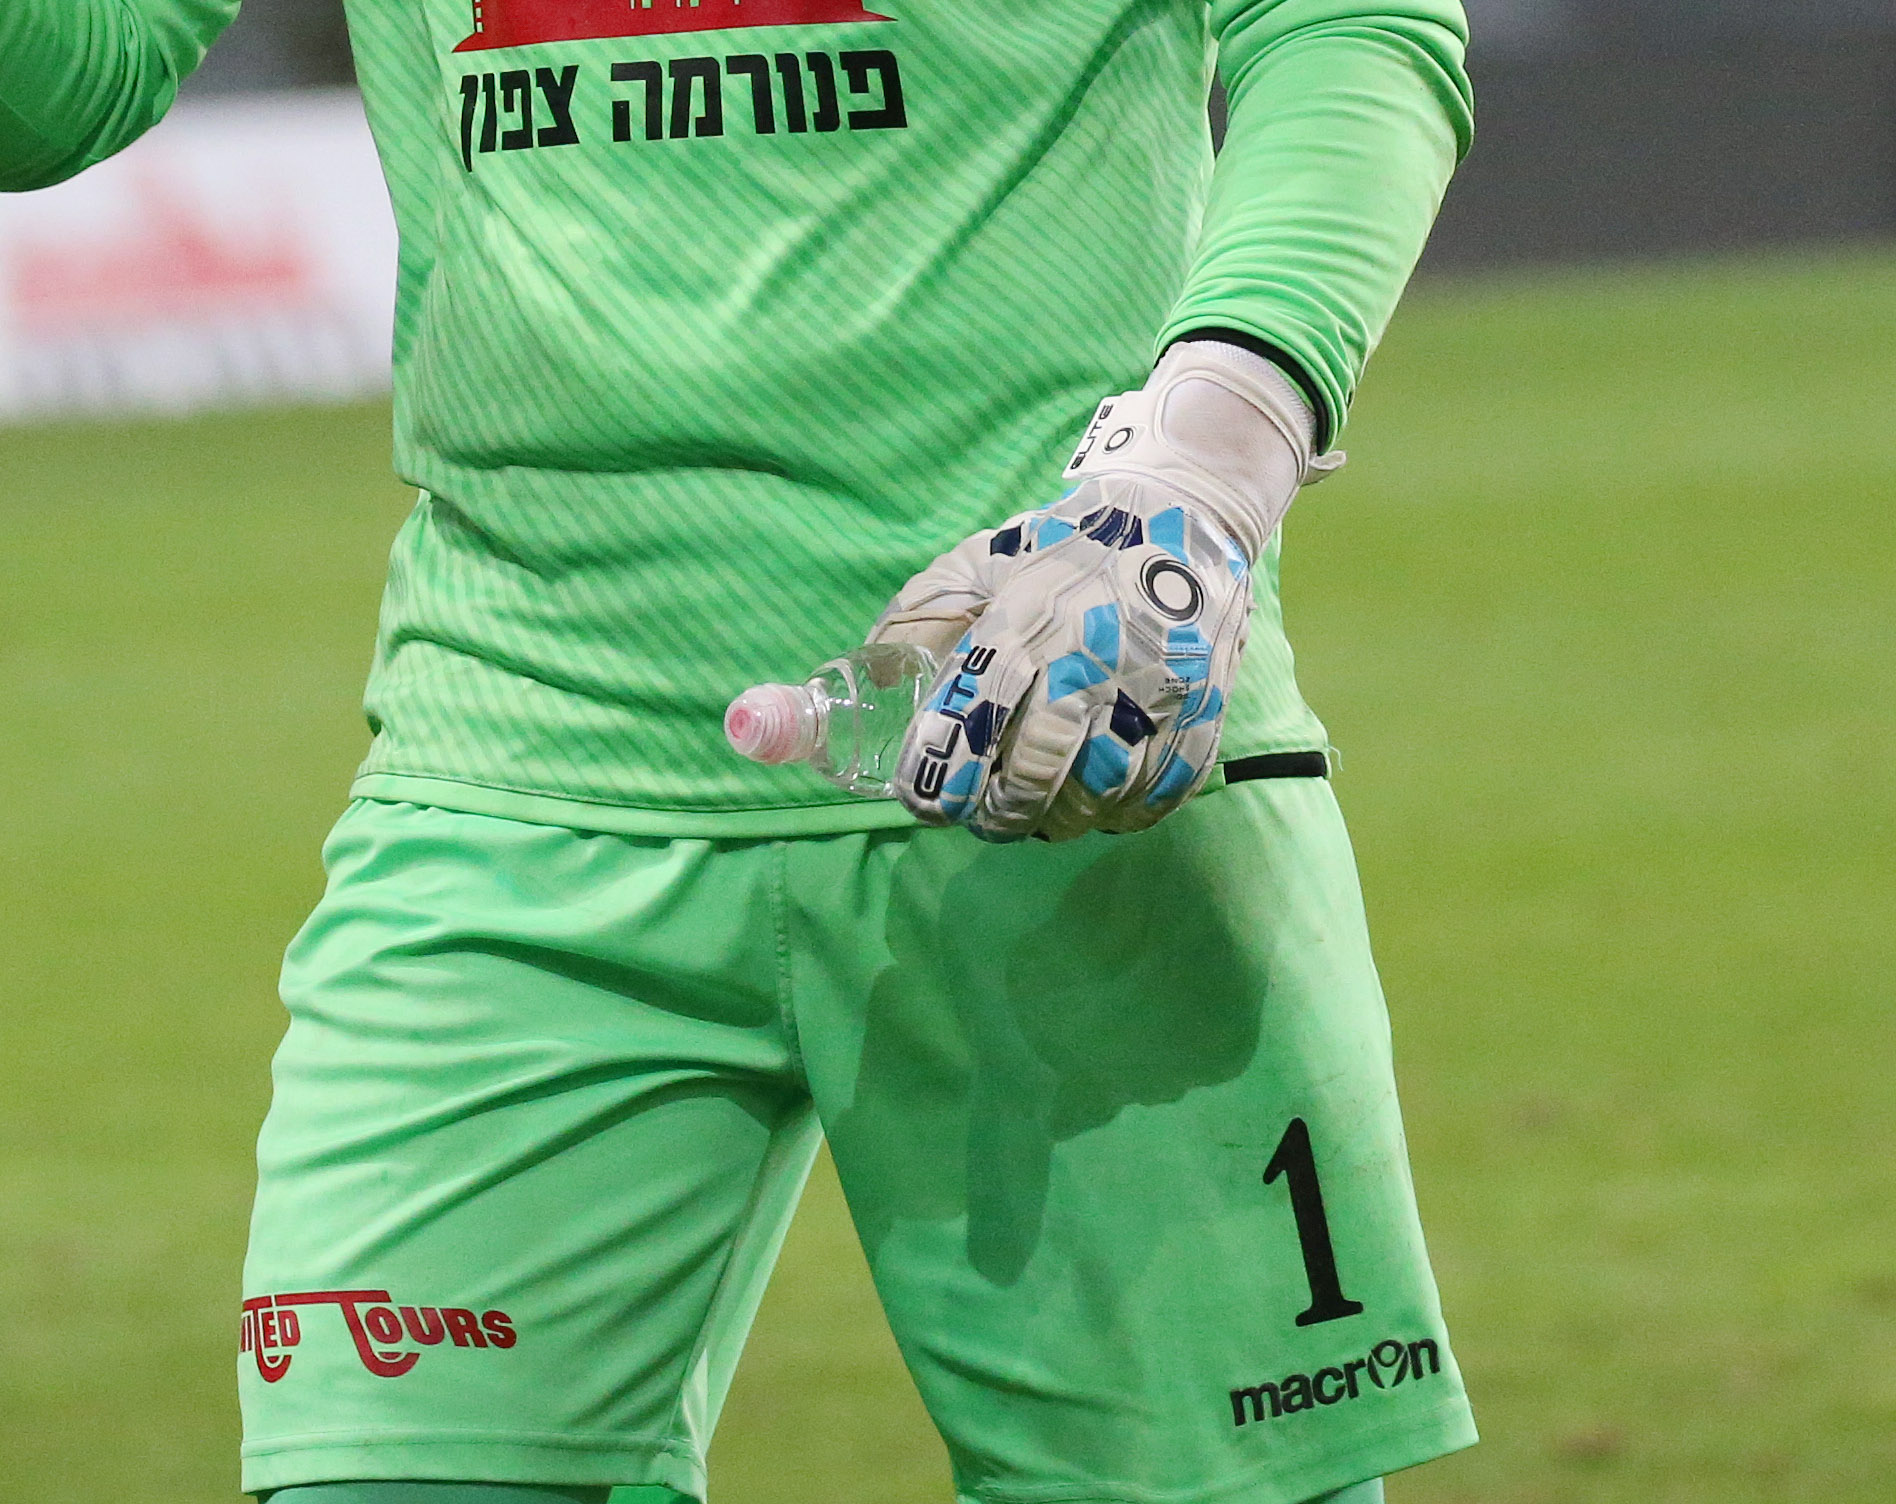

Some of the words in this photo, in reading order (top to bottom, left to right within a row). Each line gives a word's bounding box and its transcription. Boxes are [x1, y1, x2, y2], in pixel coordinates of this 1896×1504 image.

[459, 64, 580, 173] צפון
[610, 49, 908, 143] פנורמה
[1070, 403, 1114, 470] ELITE
[913, 644, 997, 800] ELITE
[1262, 1116, 1364, 1327] 1
[1229, 1337, 1441, 1427] macron
